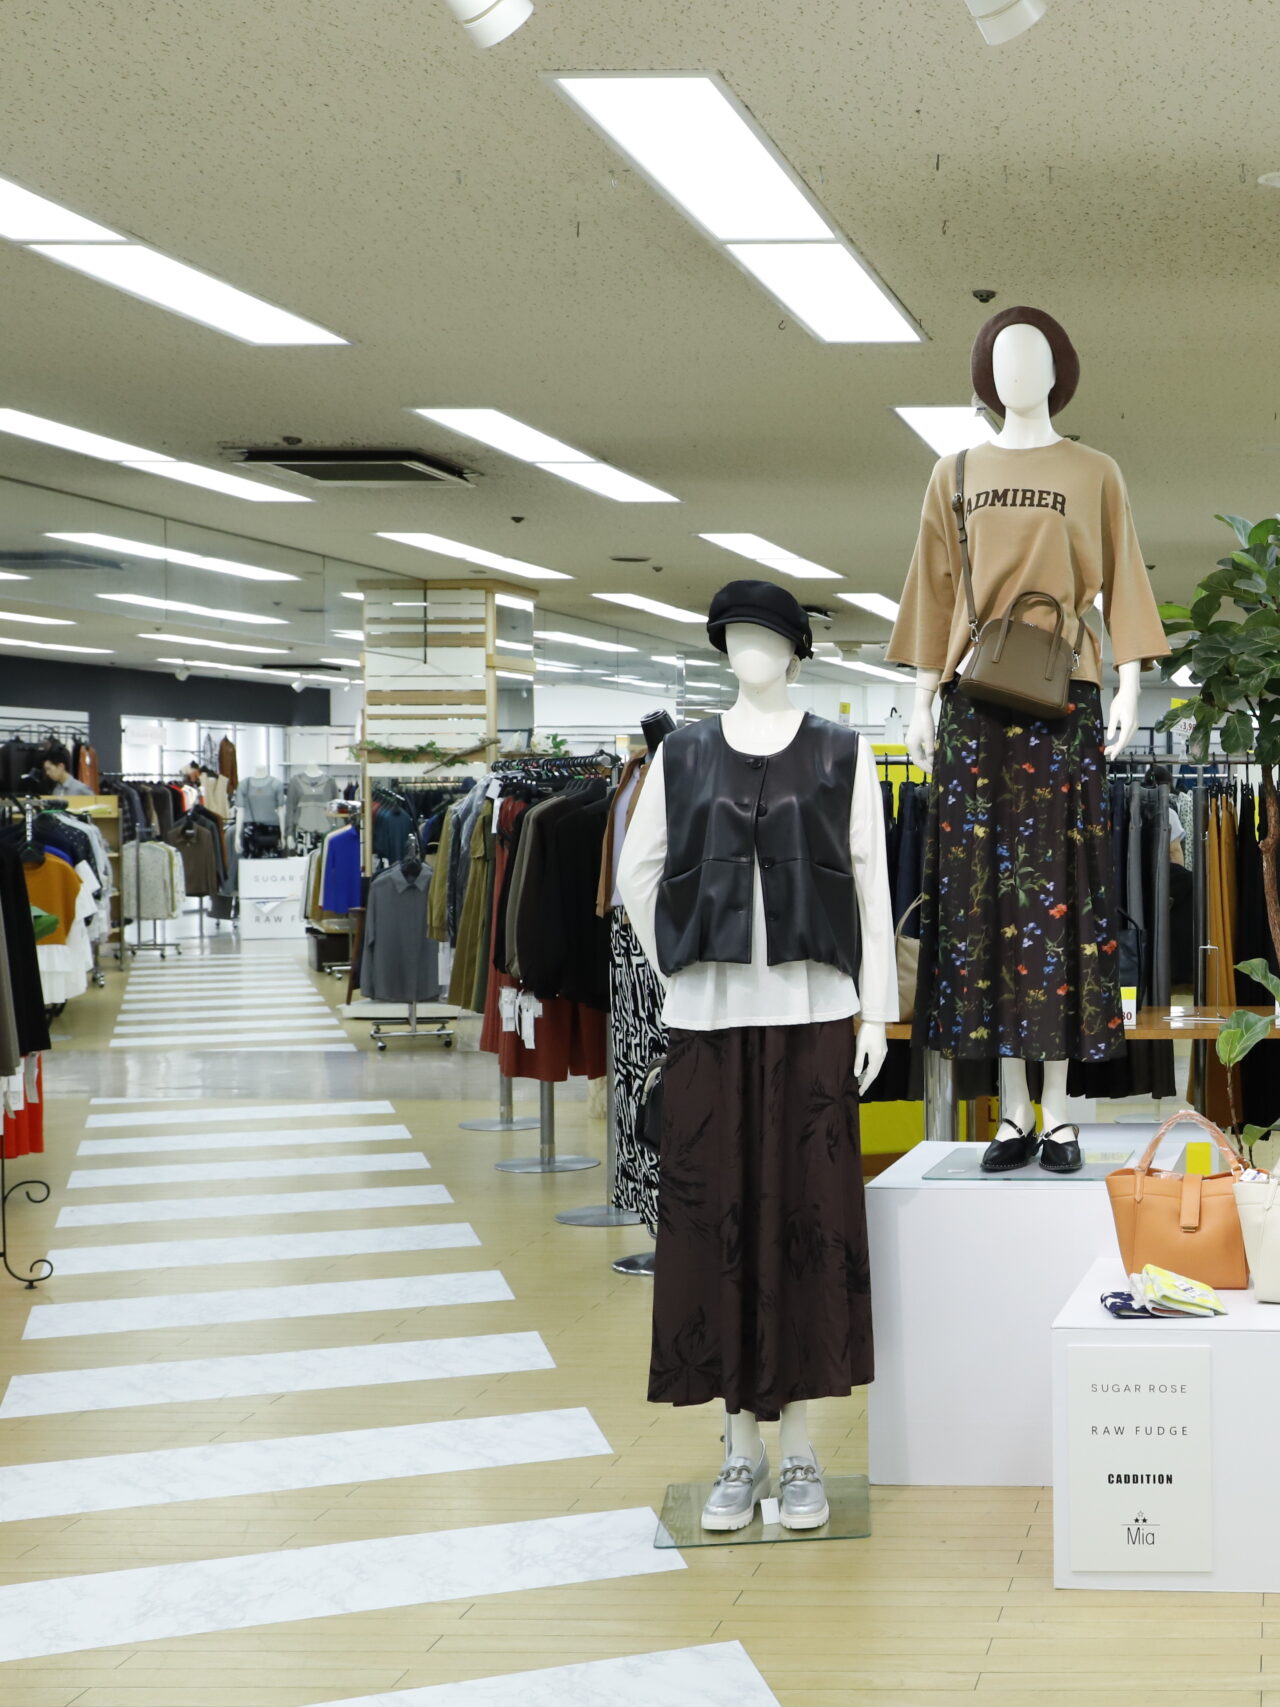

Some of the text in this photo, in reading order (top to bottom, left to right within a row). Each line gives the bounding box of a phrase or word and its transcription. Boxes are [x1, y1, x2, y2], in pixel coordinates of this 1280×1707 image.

[965, 488, 1067, 521] ADMIRER
[1091, 1383, 1188, 1394] SUGAR ROSE
[1091, 1425, 1189, 1436] RAW FUDGE
[1107, 1473, 1173, 1485] CADDITION
[1127, 1527, 1155, 1545] Mia
